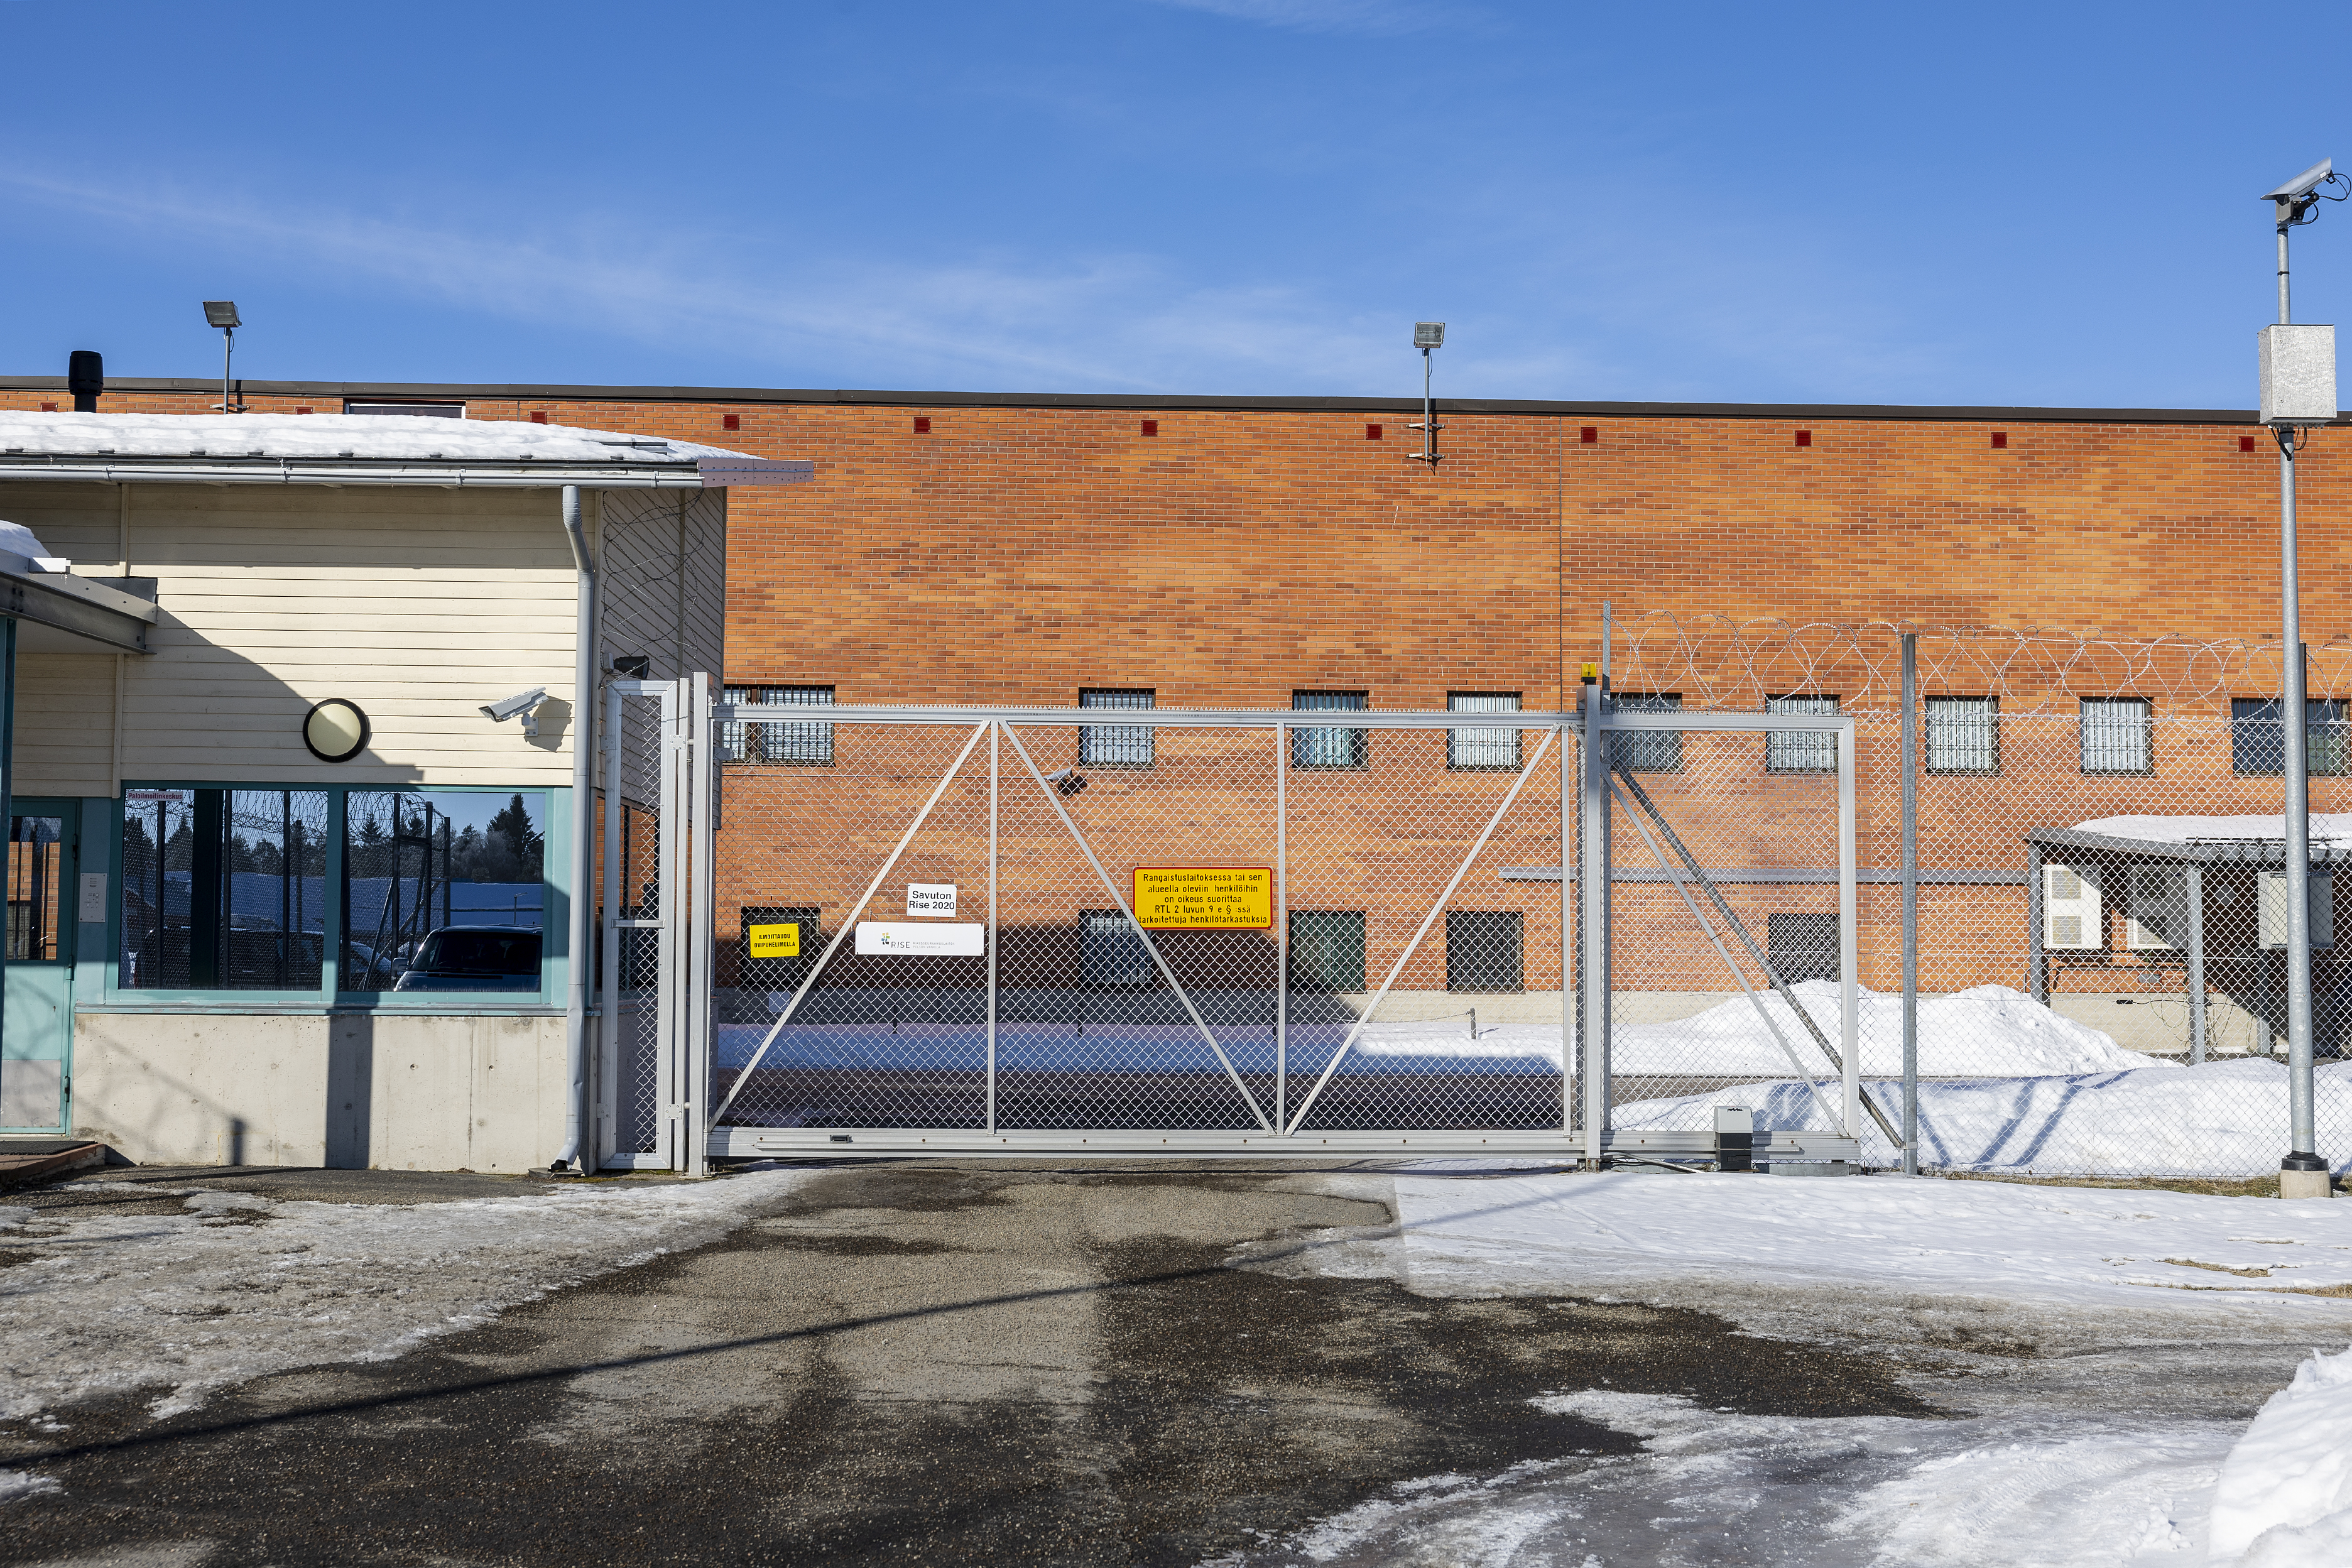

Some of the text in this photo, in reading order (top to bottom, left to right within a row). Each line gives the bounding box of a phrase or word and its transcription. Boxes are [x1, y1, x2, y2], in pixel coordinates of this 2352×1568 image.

[1143, 874, 1231, 883] Rangaistuslaitoksessa
[912, 890, 951, 899] Savuton
[909, 900, 954, 910] Rise 2020
[1155, 905, 1170, 913] RTL
[1174, 905, 1179, 913] 2
[1184, 905, 1204, 913] luvun
[1226, 905, 1231, 915] §
[1139, 915, 1187, 924] tarkoitettuja
